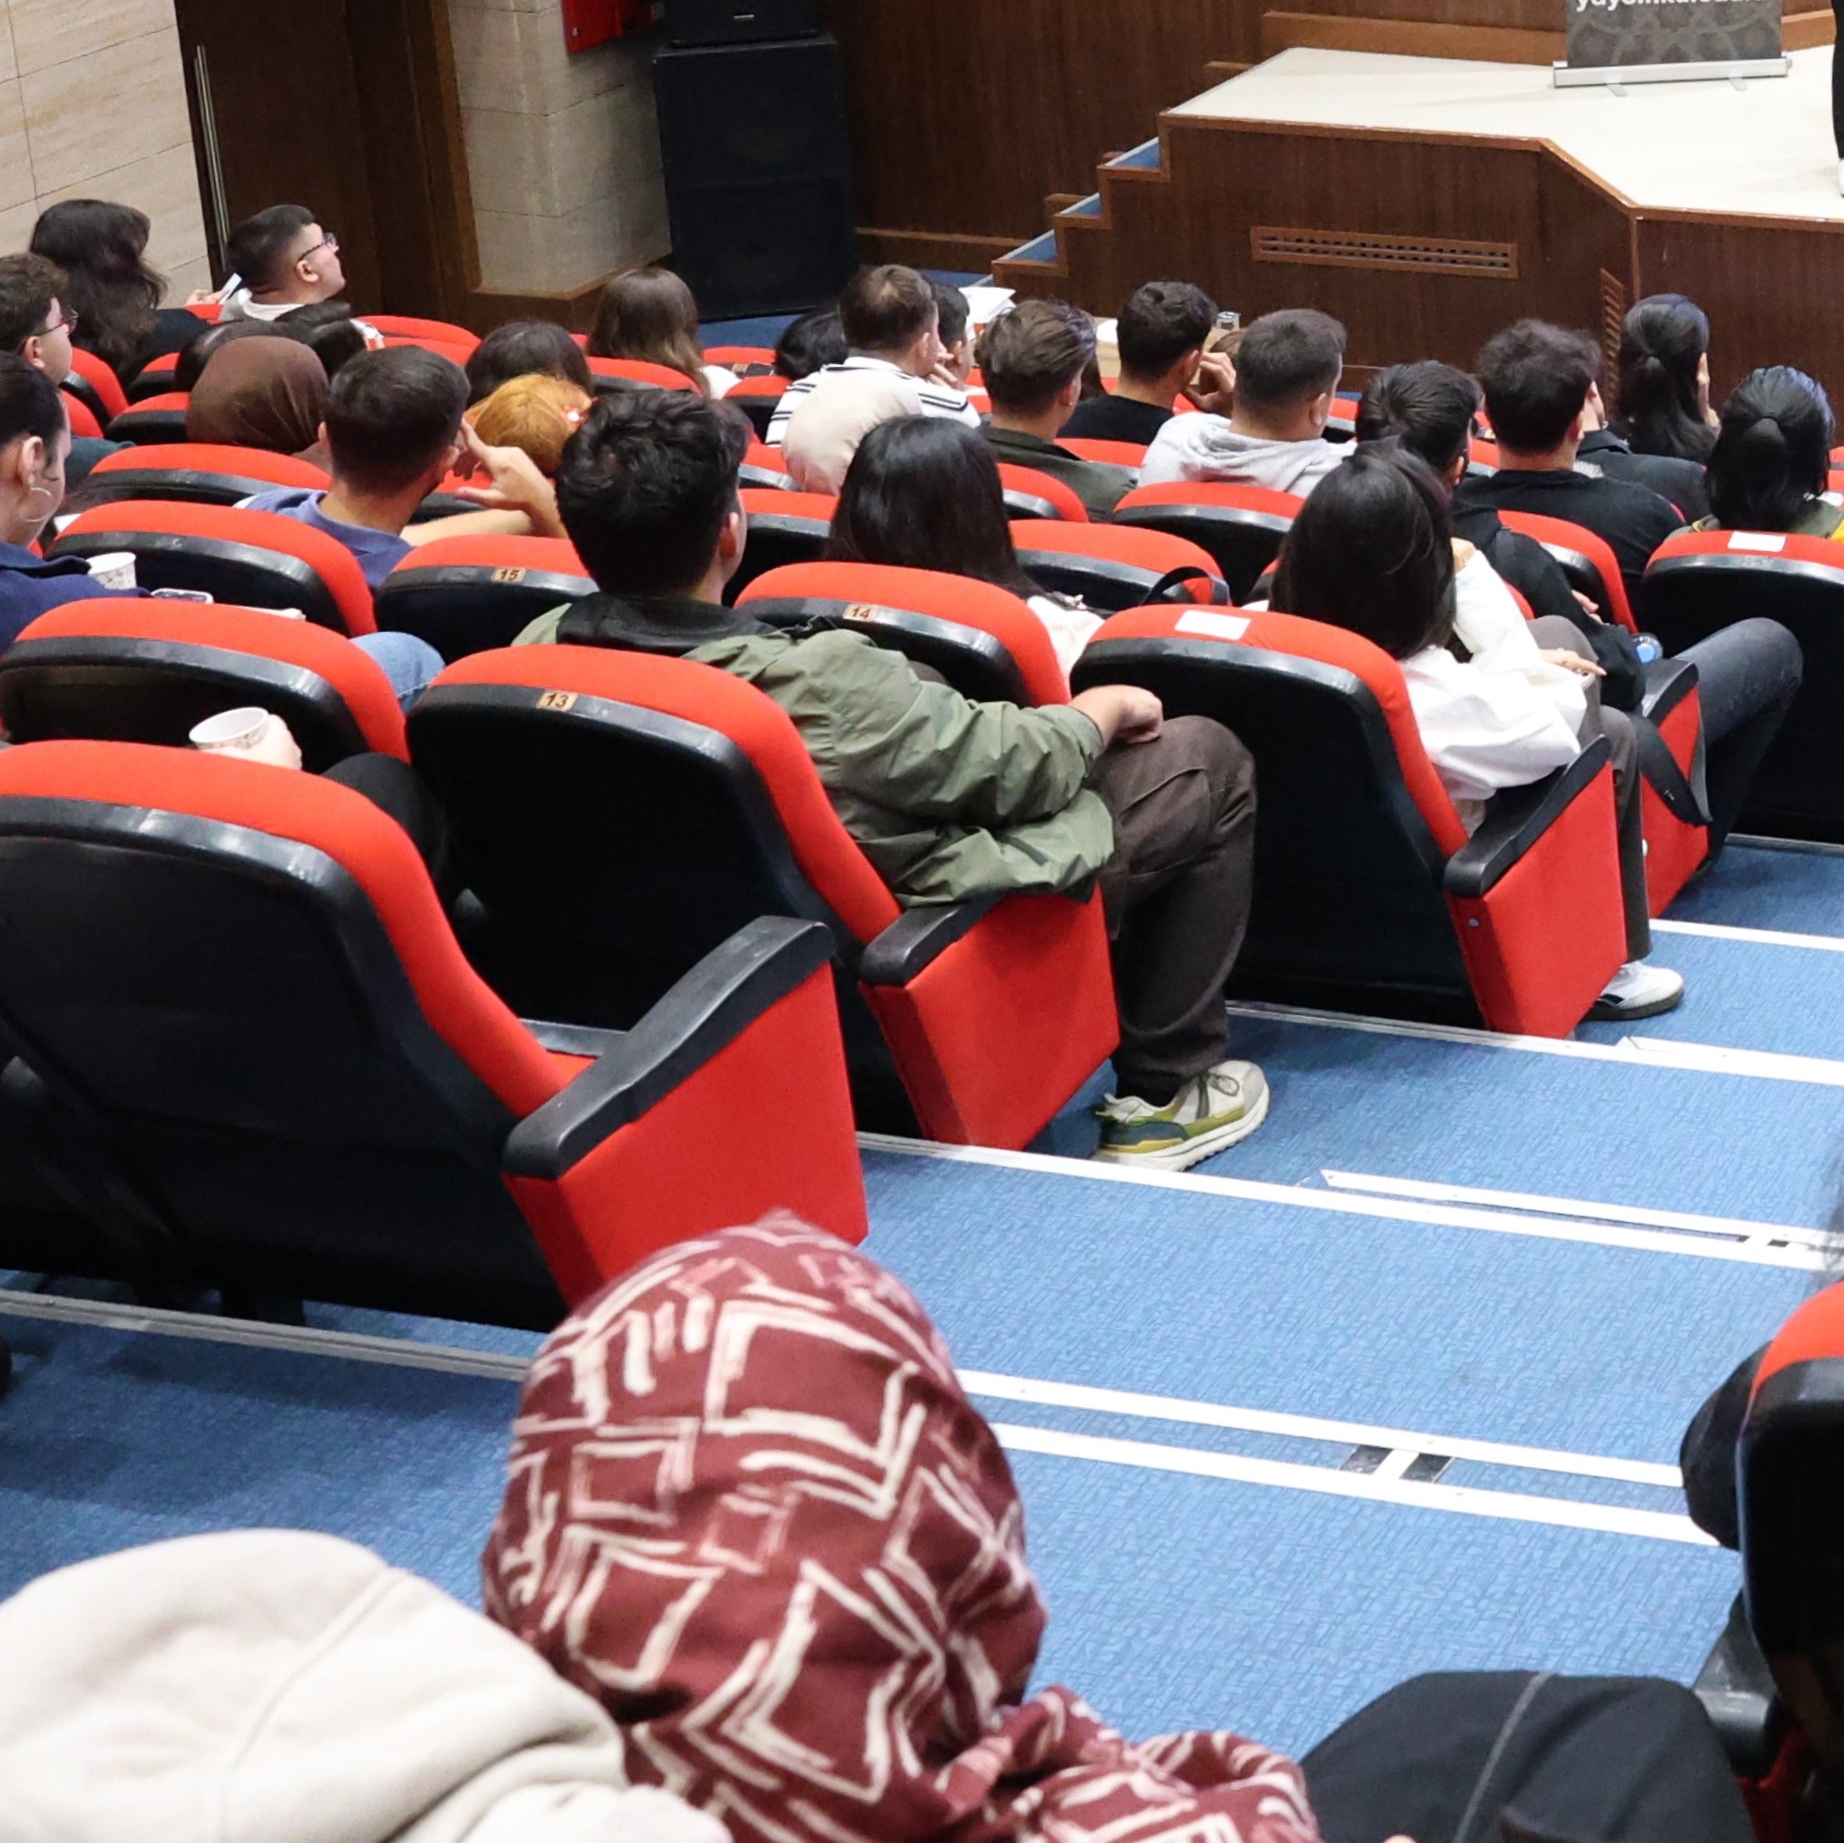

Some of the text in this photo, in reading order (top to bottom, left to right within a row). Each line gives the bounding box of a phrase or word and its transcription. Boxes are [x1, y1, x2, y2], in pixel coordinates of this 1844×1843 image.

[500, 568, 520, 581] 15
[853, 607, 871, 619] 14
[547, 692, 568, 708] 13
